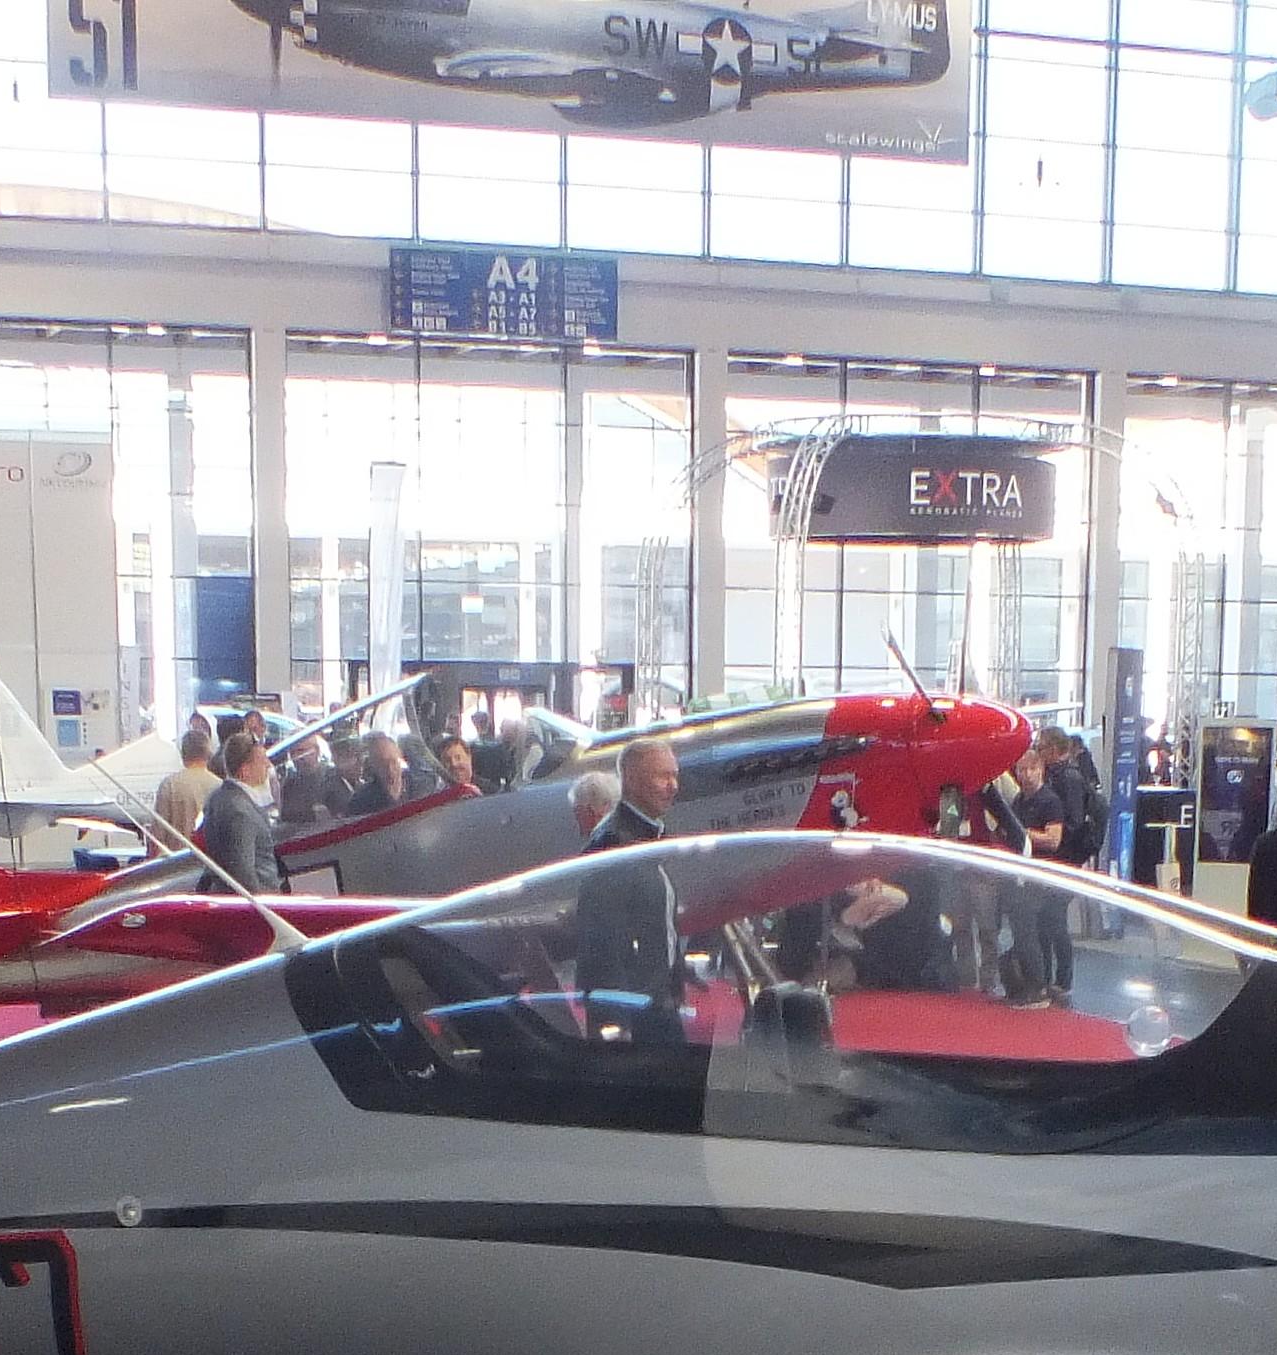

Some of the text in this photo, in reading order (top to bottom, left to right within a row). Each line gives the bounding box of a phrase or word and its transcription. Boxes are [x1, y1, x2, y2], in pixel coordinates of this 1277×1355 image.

[603, 14, 668, 60] SW
[487, 255, 539, 291] A4
[909, 470, 1023, 508] EXTRA
